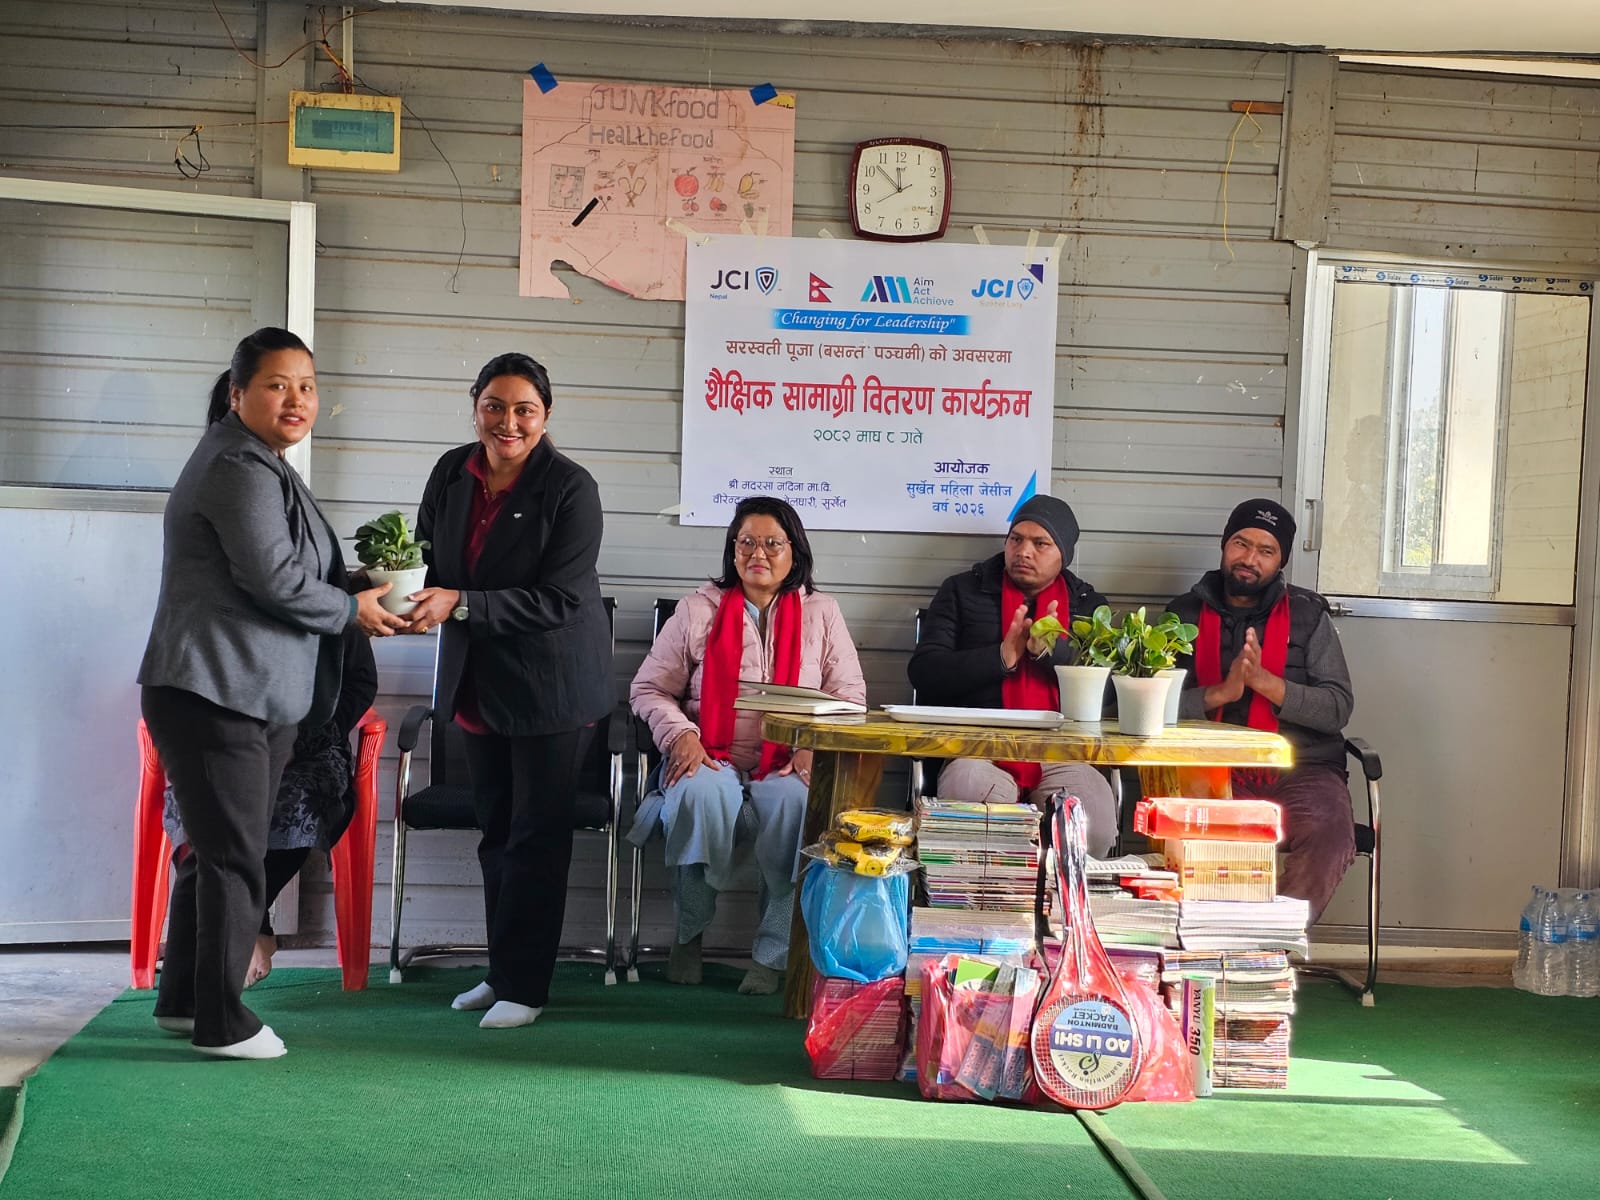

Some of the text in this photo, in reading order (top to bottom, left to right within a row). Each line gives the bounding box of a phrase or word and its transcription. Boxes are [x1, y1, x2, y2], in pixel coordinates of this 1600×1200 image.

[879, 152, 887, 164] 11
[896, 152, 907, 163] 12
[865, 165, 876, 177] 10
[929, 166, 937, 178] 2
[862, 183, 870, 195] 9
[929, 185, 937, 197] 3
[863, 203, 871, 214] 8
[927, 205, 934, 216] 4
[878, 216, 885, 227] 7
[895, 218, 902, 229] 6
[912, 218, 920, 229] 5
[710, 269, 749, 290] JCI
[913, 277, 934, 286] Aim
[913, 287, 930, 295] Act
[971, 278, 1014, 298] JCI
[709, 292, 728, 300] Nepal
[912, 296, 955, 306] Achieve
[774, 311, 956, 333] "Changing for Leadership"
[725, 338, 782, 355] सरस्वती
[786, 343, 814, 361] पूजा
[874, 343, 925, 362] पञ्चमी)
[929, 344, 948, 361] को
[952, 349, 1012, 363] अवसरमा
[705, 367, 1032, 419] शैक्षिक सामाग्री वितरण कार्यक्रम
[813, 428, 924, 444] २०८२ माघ ८ गते
[769, 466, 793, 476] स्थान
[934, 459, 990, 474] आयोजक
[728, 479, 738, 489] श्री
[741, 480, 773, 491] मदरसा
[906, 480, 1012, 498] सुर्खेत महिला जेसीज
[932, 499, 984, 516] वर्ष २०२६
[1072, 1011, 1116, 1023] RACKET
[1067, 1019, 1118, 1031] BADMINTON
[1055, 1031, 1130, 1053] AO LI SHI
[1189, 1026, 1201, 1056] 350
